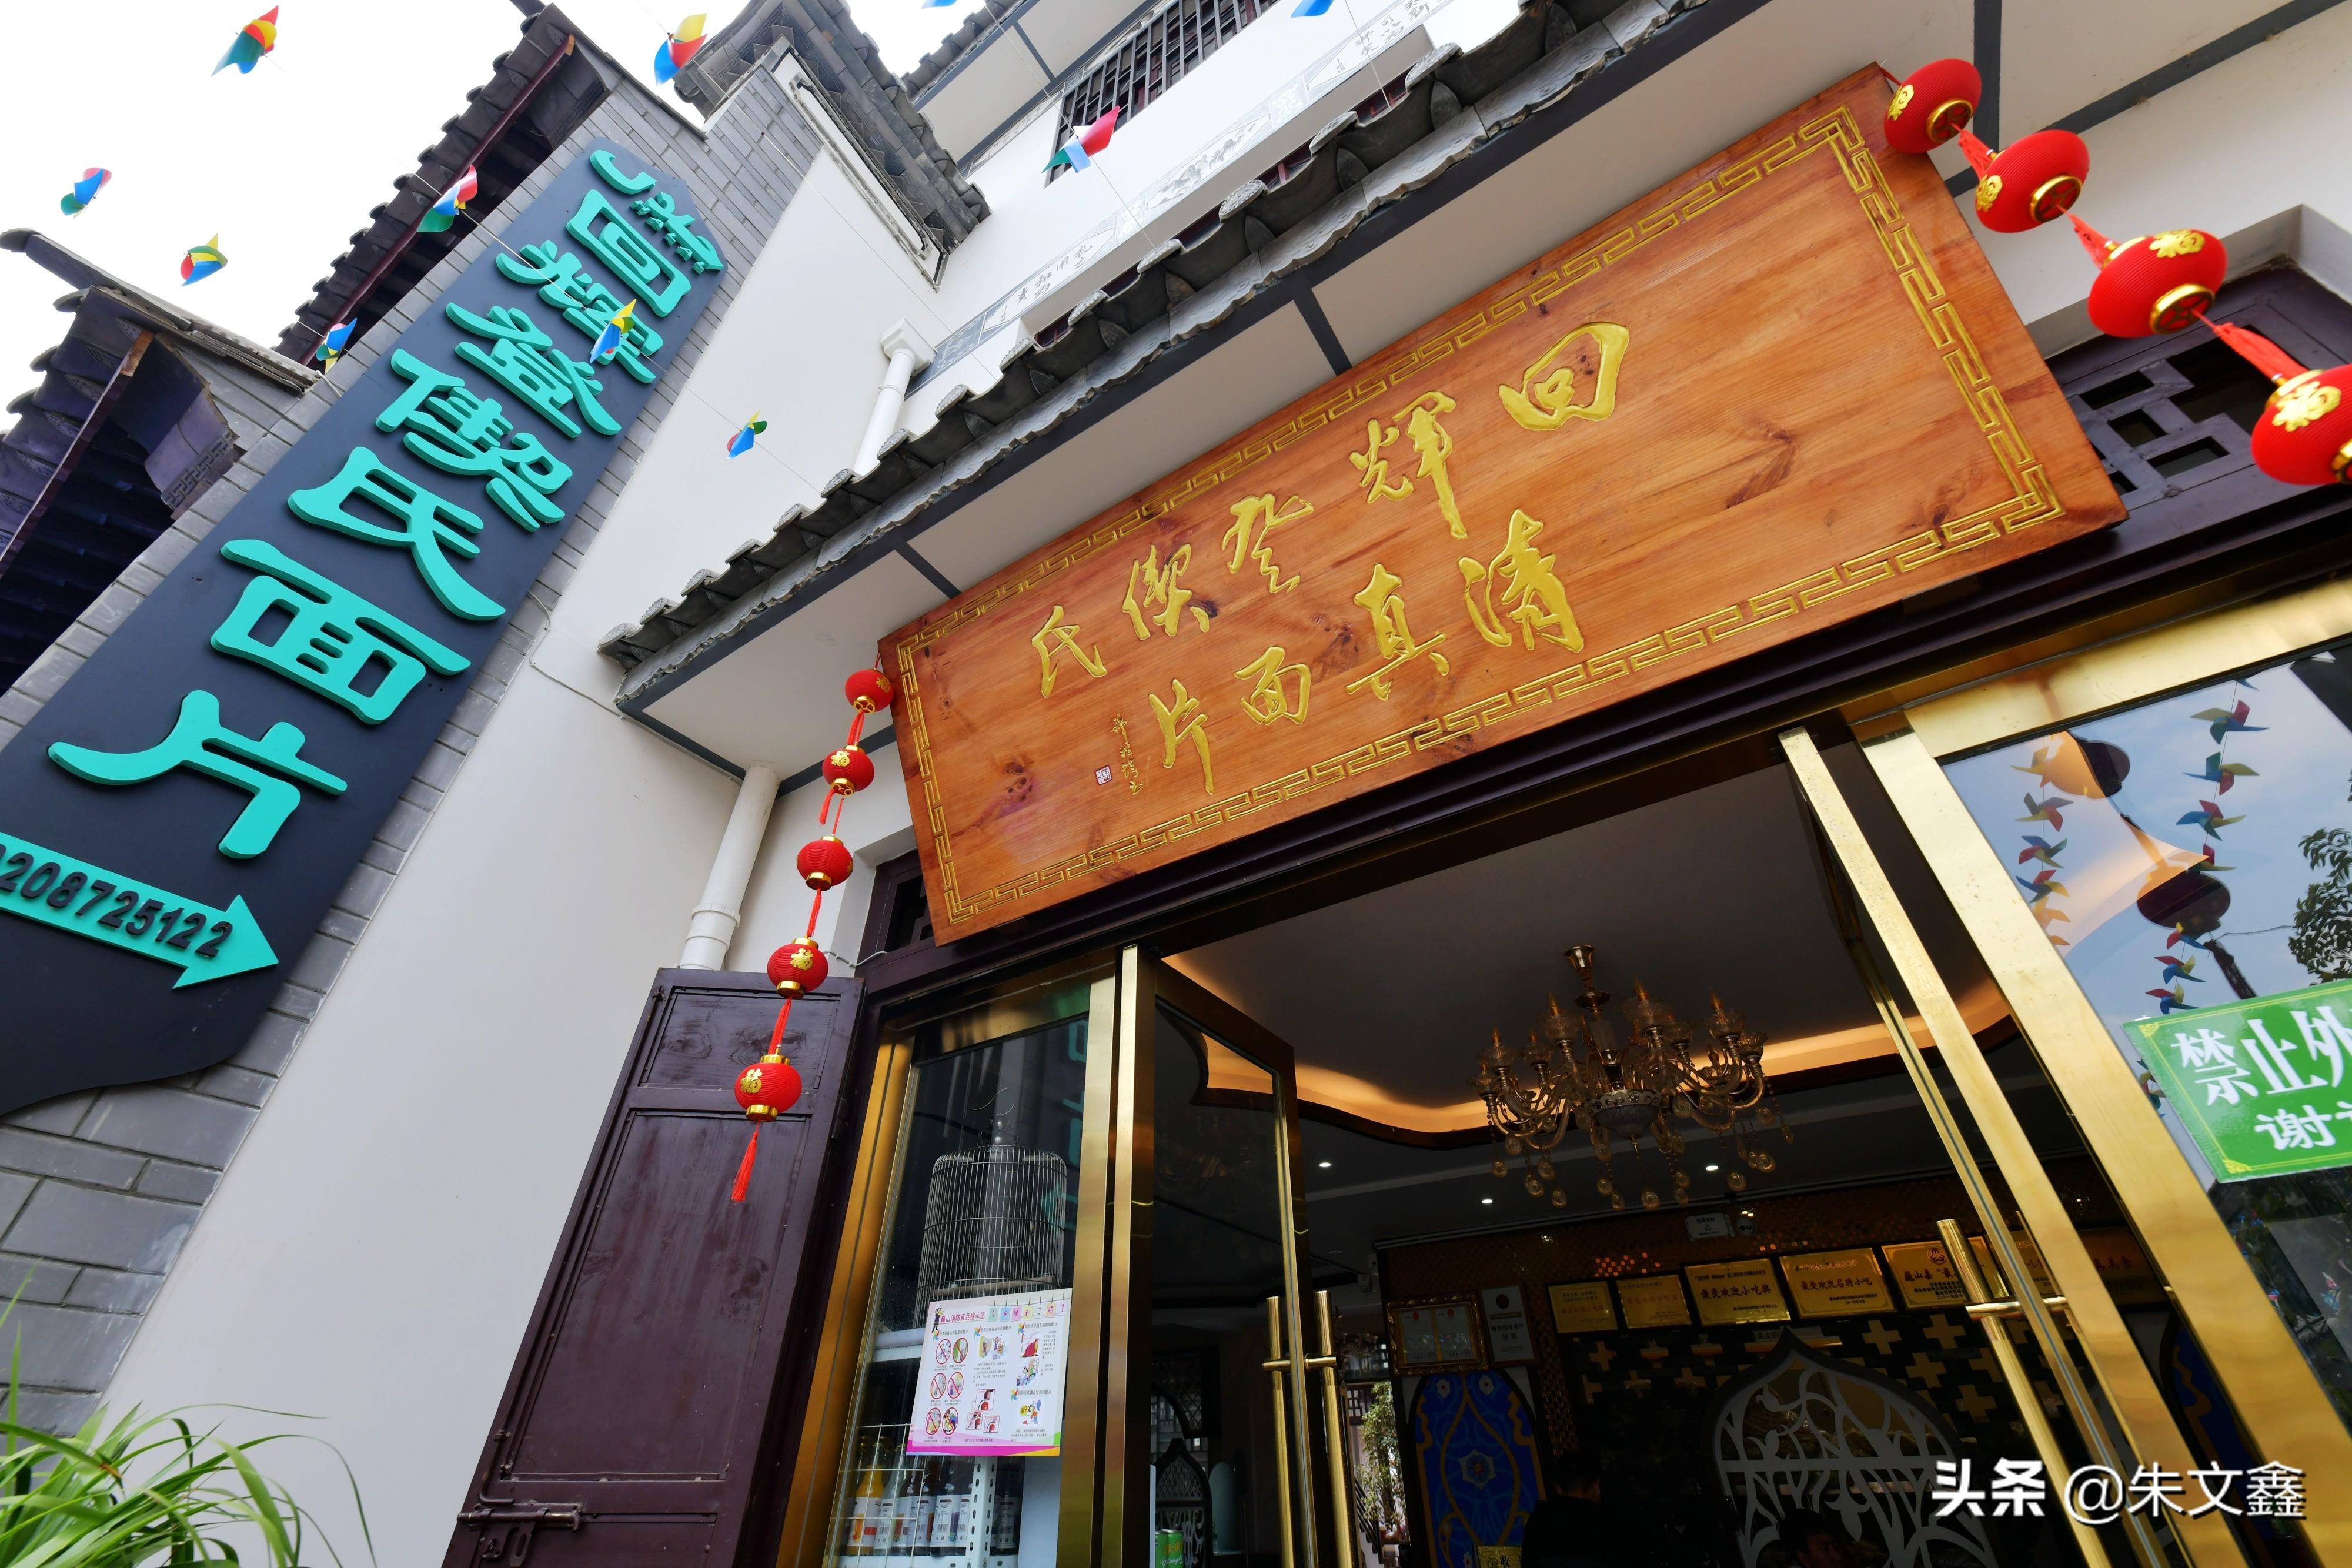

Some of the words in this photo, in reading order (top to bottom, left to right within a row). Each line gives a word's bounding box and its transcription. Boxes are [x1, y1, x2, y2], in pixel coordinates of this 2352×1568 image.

[630, 200, 706, 275] HALAL
[1148, 509, 1584, 795] 清真面片
[831, 751, 850, 767] 福
[0, 843, 234, 958] 208725122
[790, 948, 813, 970] 福
[740, 1069, 762, 1093] 福
[2254, 1101, 2352, 1150] 谢
[1801, 1276, 1873, 1291] 最受欢迎名特小吃
[1904, 1268, 1958, 1282] 巍山县“最
[1700, 1283, 1772, 1300] 最受欢迎小吃奖
[940, 1311, 985, 1323] 巍山消防官兵提示您
